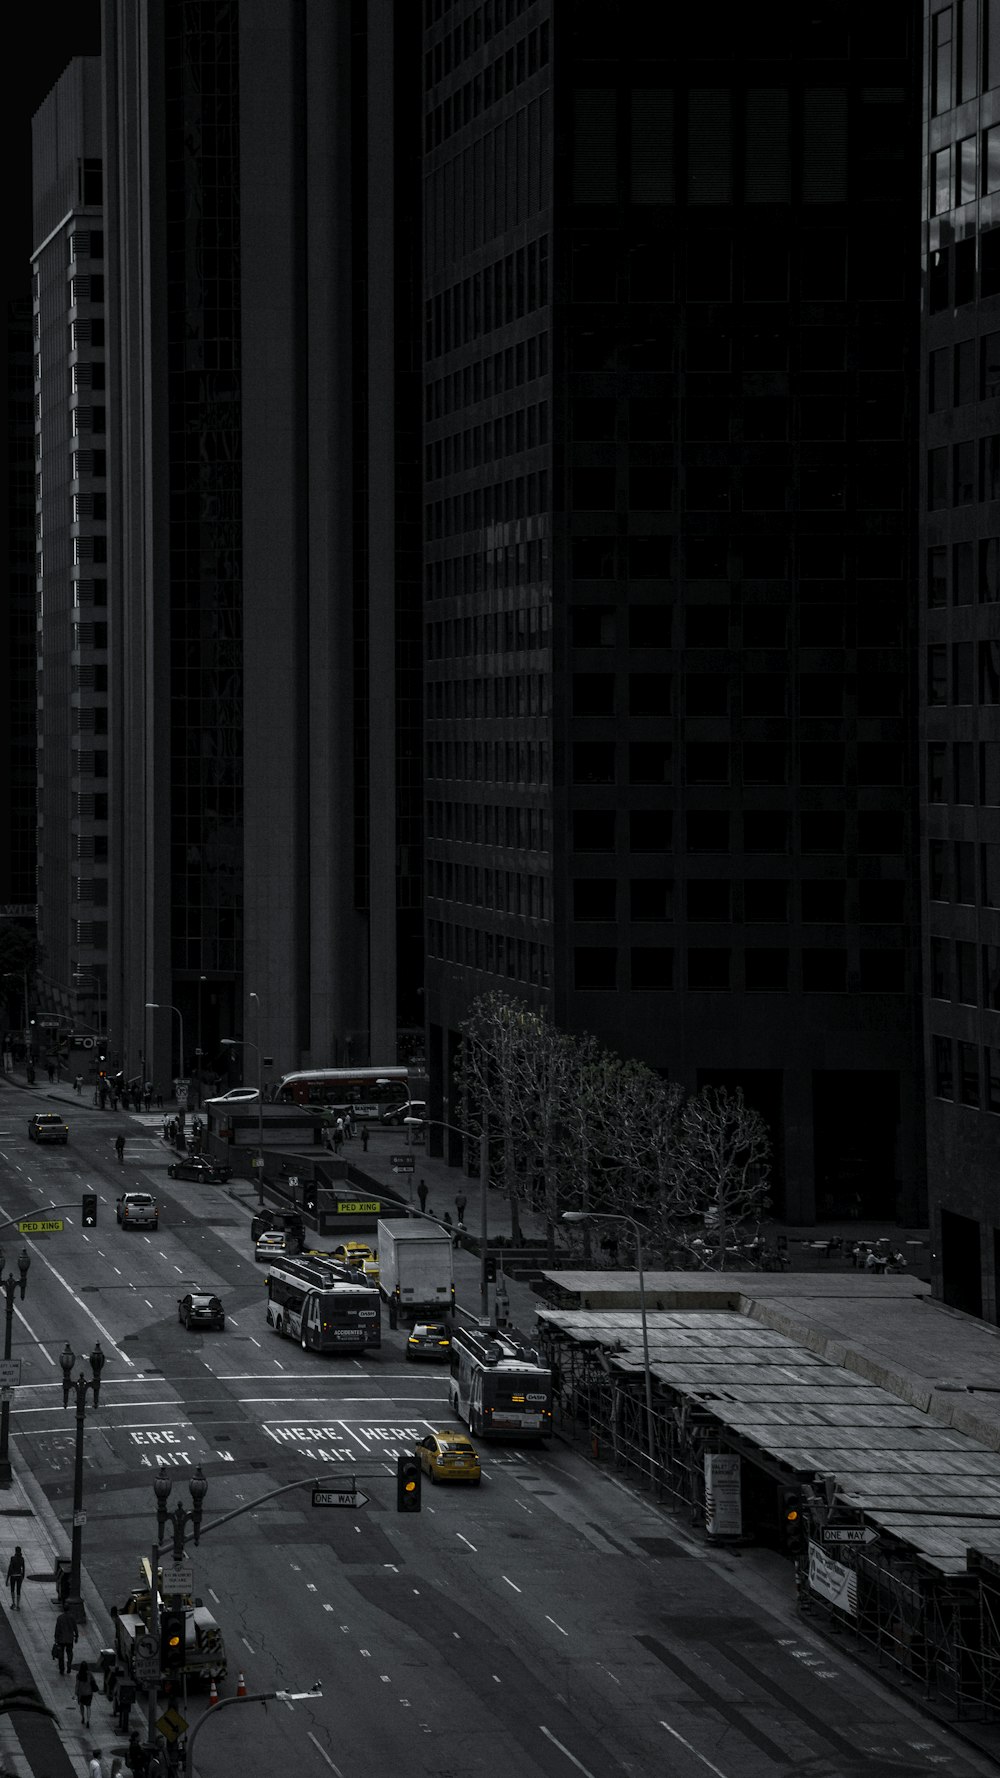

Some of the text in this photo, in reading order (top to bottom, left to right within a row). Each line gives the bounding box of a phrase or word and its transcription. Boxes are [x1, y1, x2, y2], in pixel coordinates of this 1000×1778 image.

[129, 1431, 181, 1445] ERE
[274, 1428, 343, 1440] HERE
[359, 1428, 424, 1440] HERE
[315, 1494, 356, 1503] ONE WAY
[825, 1531, 865, 1540] ONE WAY
